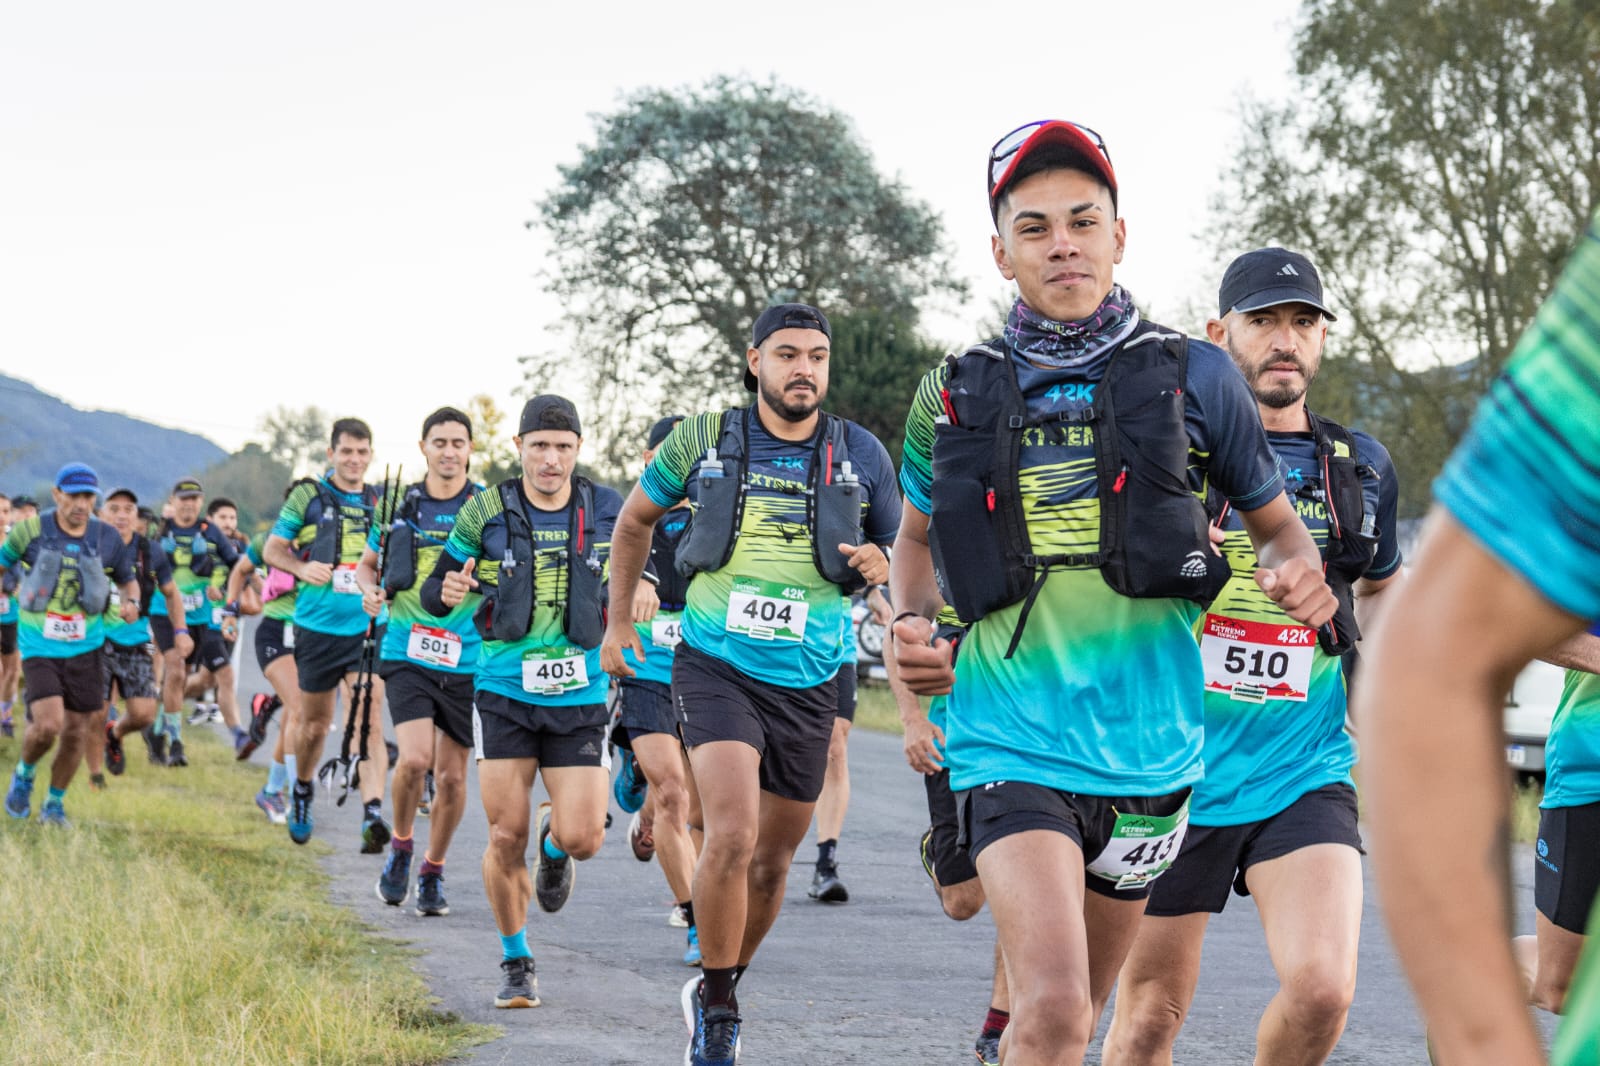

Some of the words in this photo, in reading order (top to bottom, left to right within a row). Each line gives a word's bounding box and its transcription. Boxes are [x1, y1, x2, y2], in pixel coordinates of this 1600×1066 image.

[1044, 383, 1097, 404] 42K
[781, 586, 807, 601] 42K
[742, 599, 792, 625] 404
[1210, 623, 1247, 638] EXTREMO
[1277, 628, 1312, 644] 42K
[420, 636, 450, 655] 501
[536, 659, 576, 681] 403
[1224, 645, 1290, 680] 510
[1120, 825, 1155, 834] EXTREMO
[1120, 830, 1179, 867] 413
